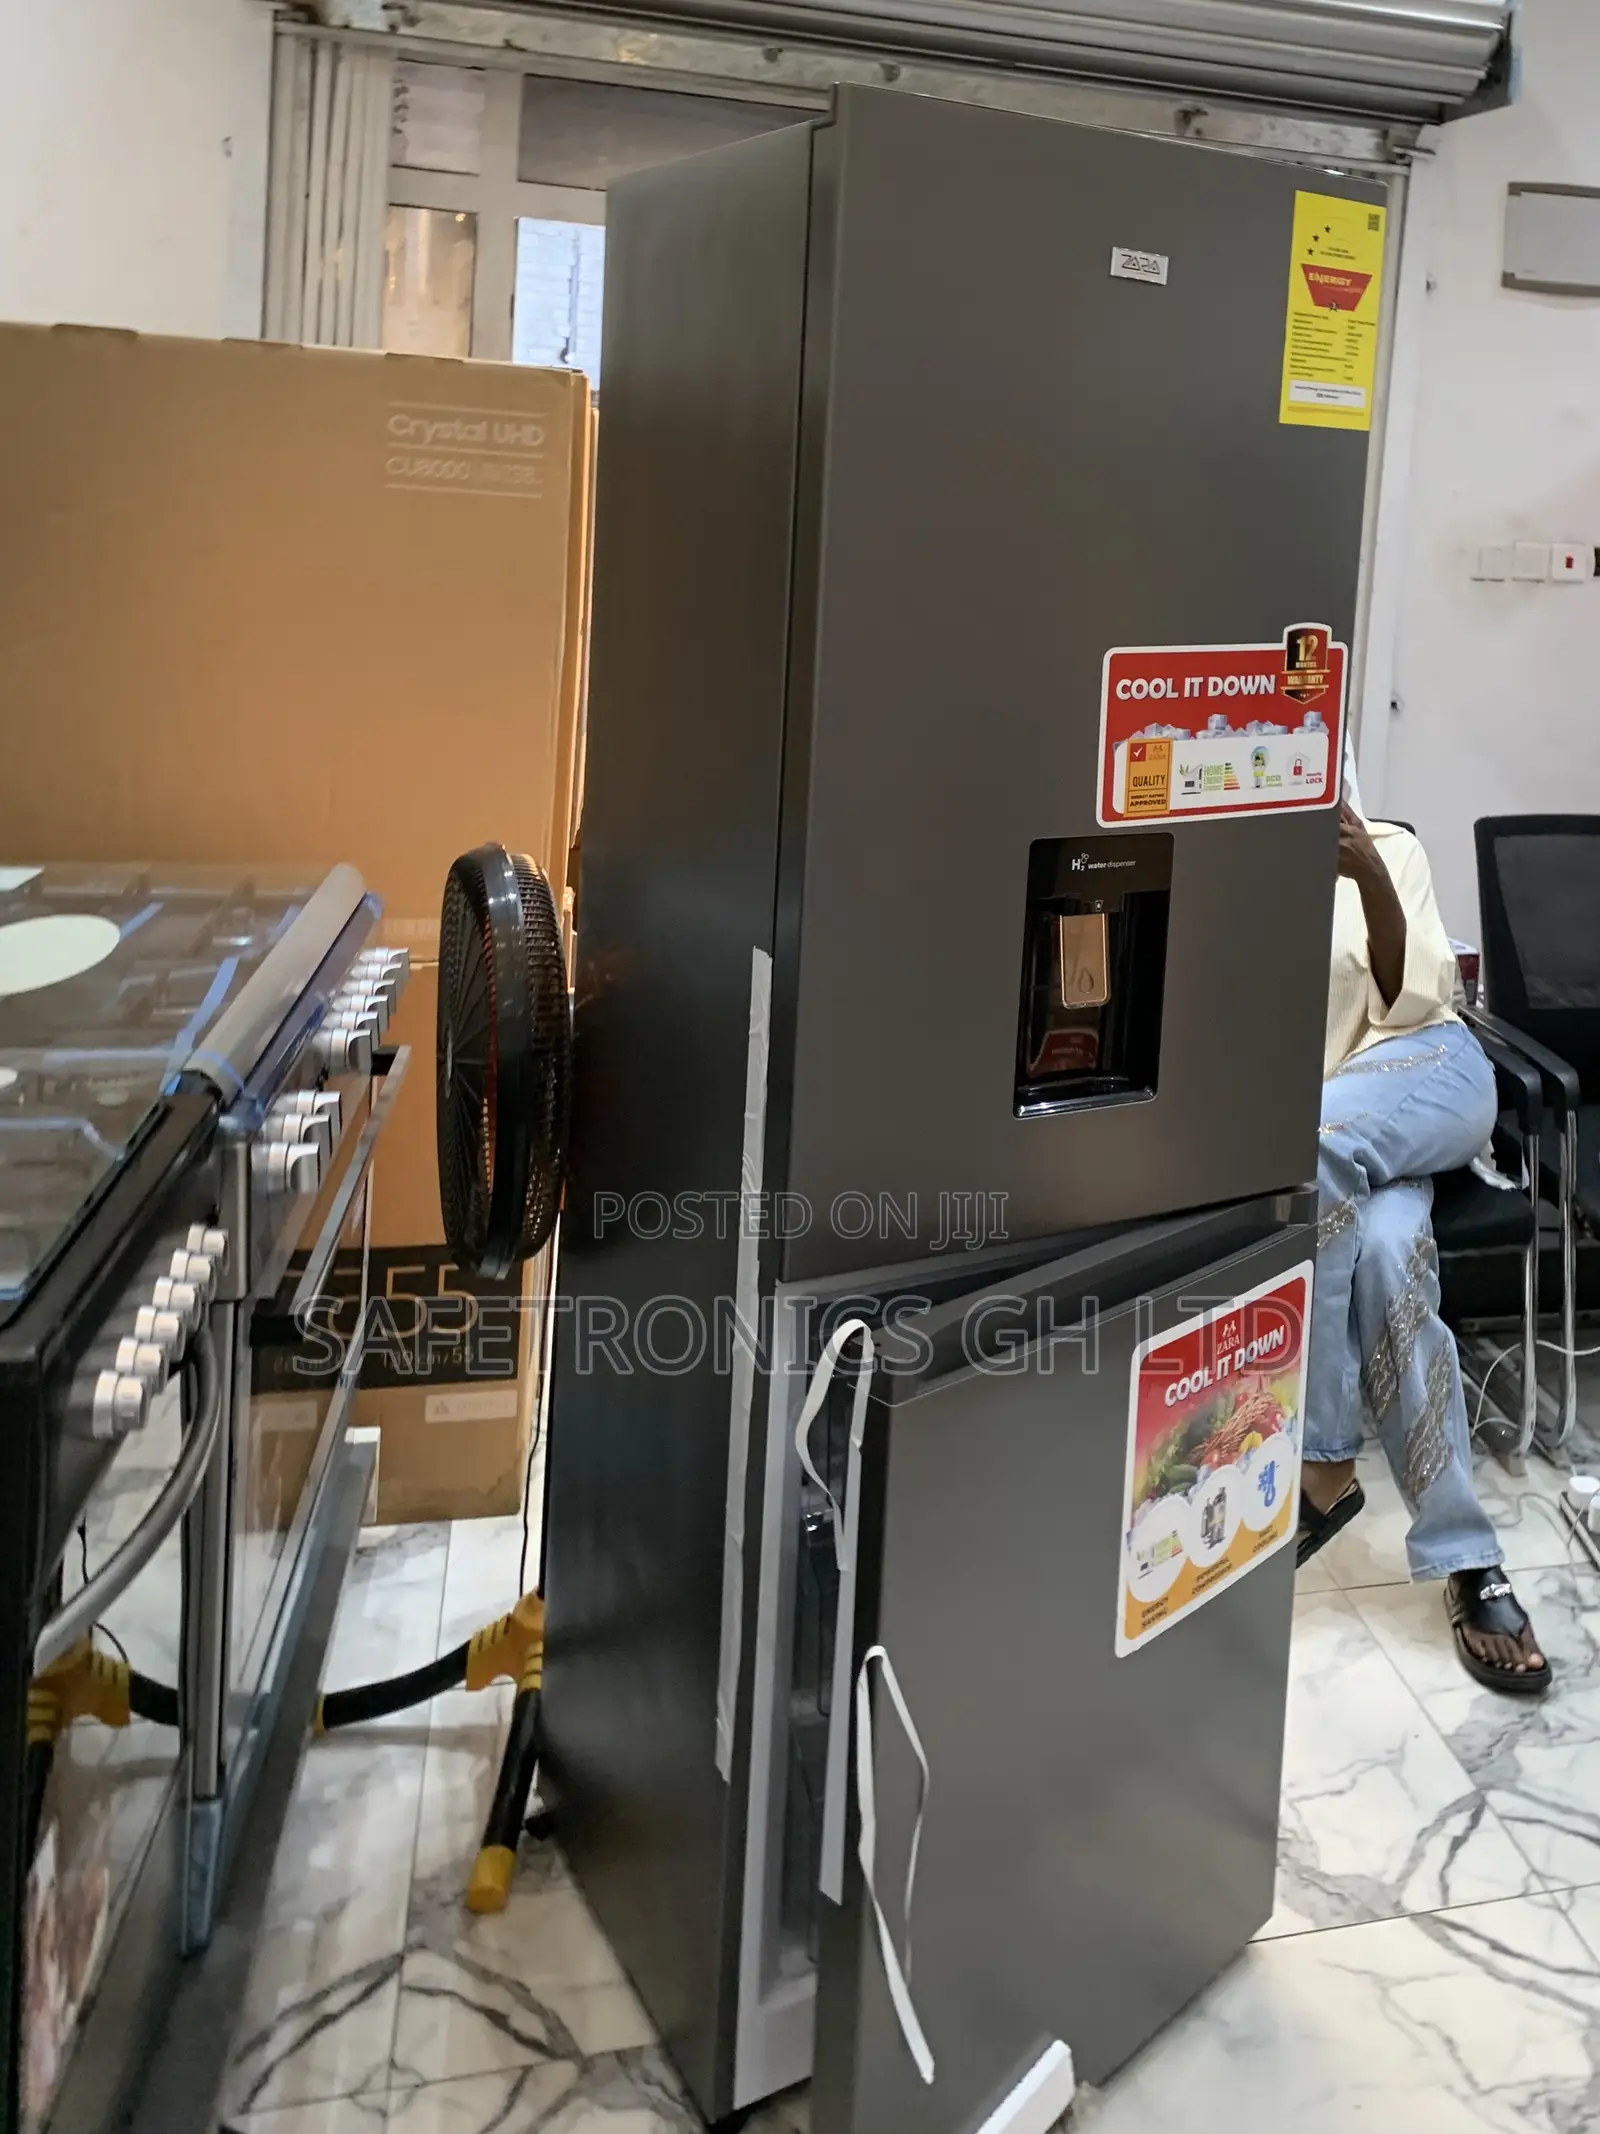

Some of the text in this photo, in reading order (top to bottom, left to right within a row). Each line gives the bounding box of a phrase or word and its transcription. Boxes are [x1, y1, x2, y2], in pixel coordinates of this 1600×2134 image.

[1308, 271, 1353, 286] ENERGY
[387, 412, 546, 447] Crystal UHD
[1297, 634, 1319, 662] 12
[1115, 674, 1276, 700] COOL IT DOWN
[1287, 674, 1325, 686] WARRANTY
[1132, 774, 1166, 788] QUALITY
[1305, 777, 1323, 785] LOCK
[1129, 798, 1167, 807] APPROVED
[1088, 862, 1107, 870] water
[1107, 860, 1137, 870] dispenser
[380, 1263, 479, 1339] 55
[1216, 1334, 1241, 1356] ZARA
[1164, 1324, 1285, 1408] COOL IT DOWN
